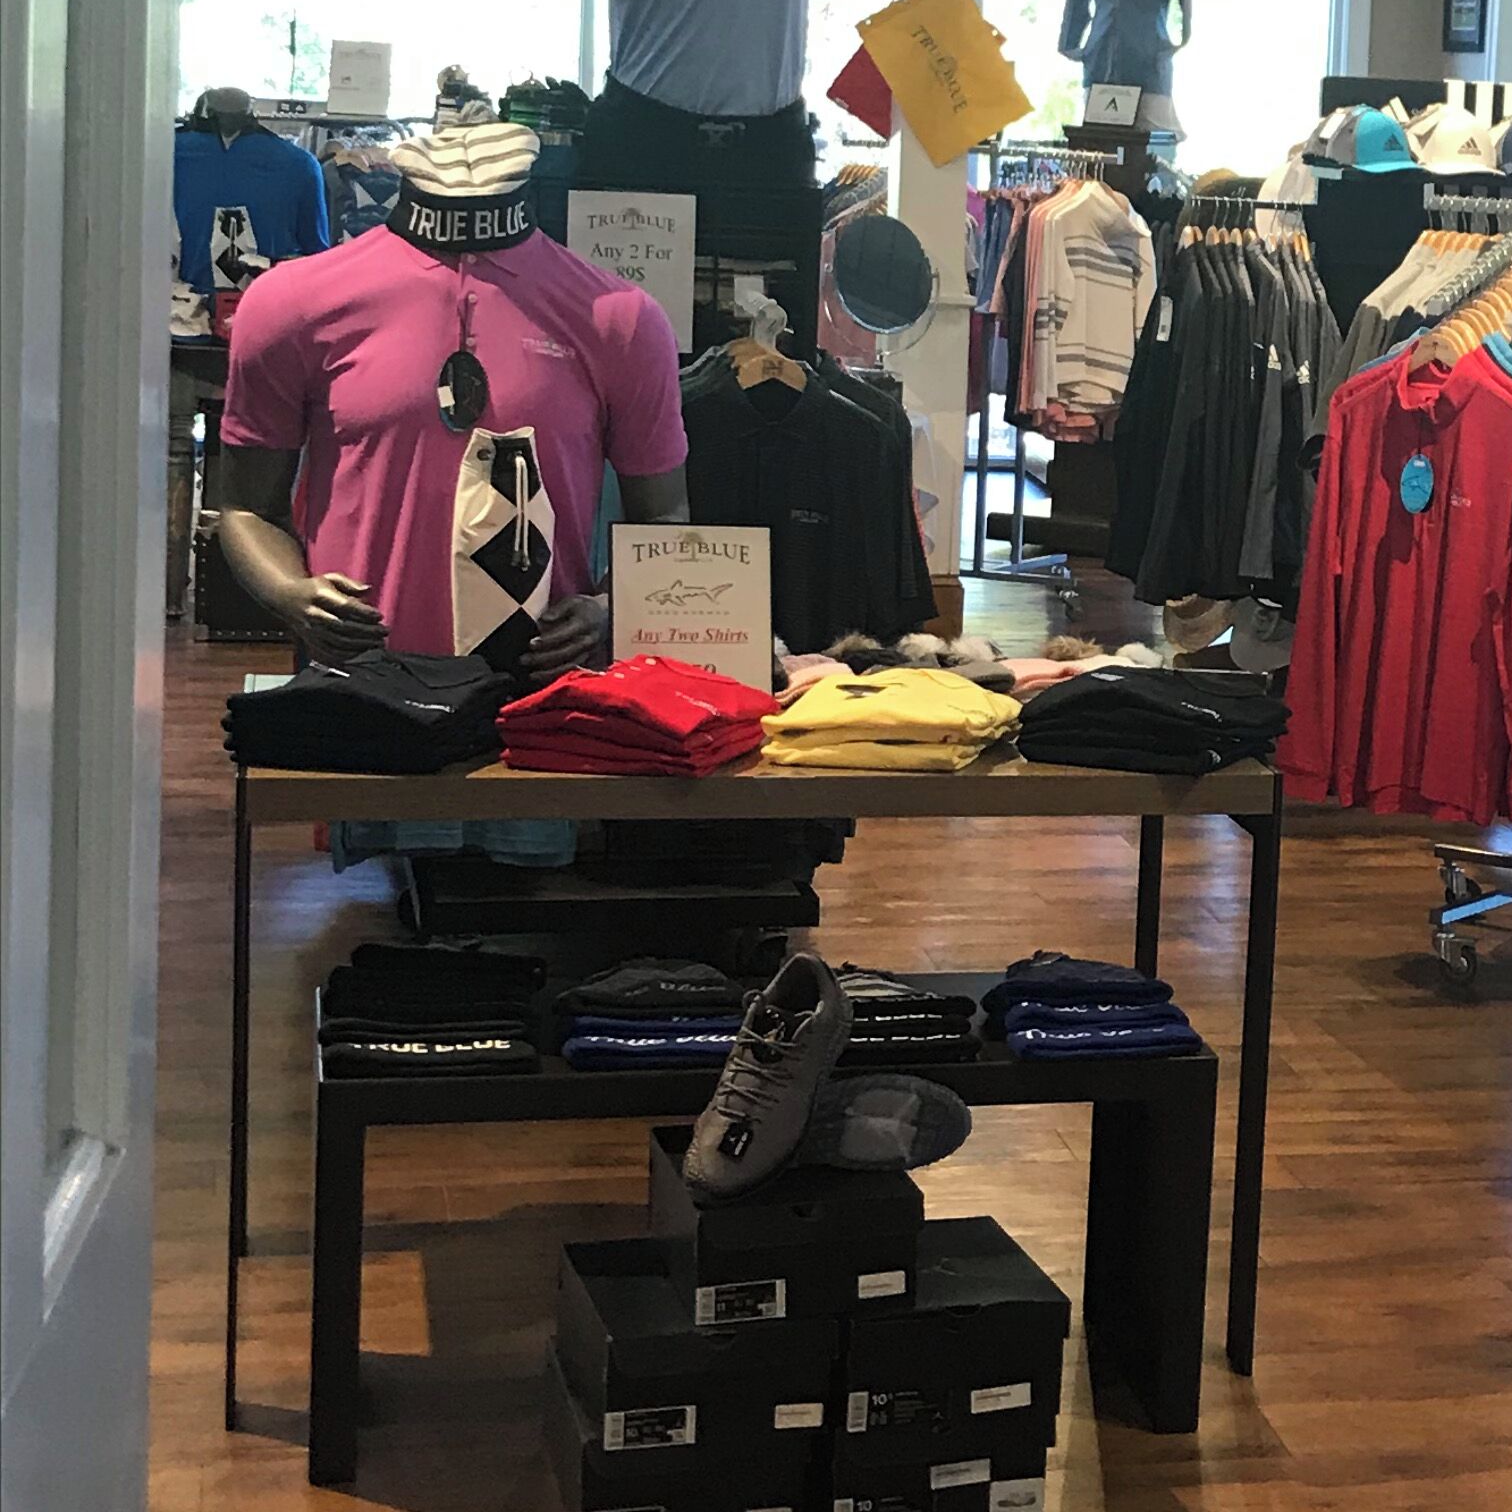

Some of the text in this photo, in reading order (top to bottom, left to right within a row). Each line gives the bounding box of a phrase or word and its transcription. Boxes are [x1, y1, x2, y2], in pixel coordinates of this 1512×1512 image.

[408, 201, 529, 242] TRUE BLUE
[587, 214, 676, 234] TRUE BLUE
[590, 242, 673, 262] Any 2 For
[632, 541, 751, 565] TRUE BLUE
[632, 628, 749, 644] Any Two Shirts
